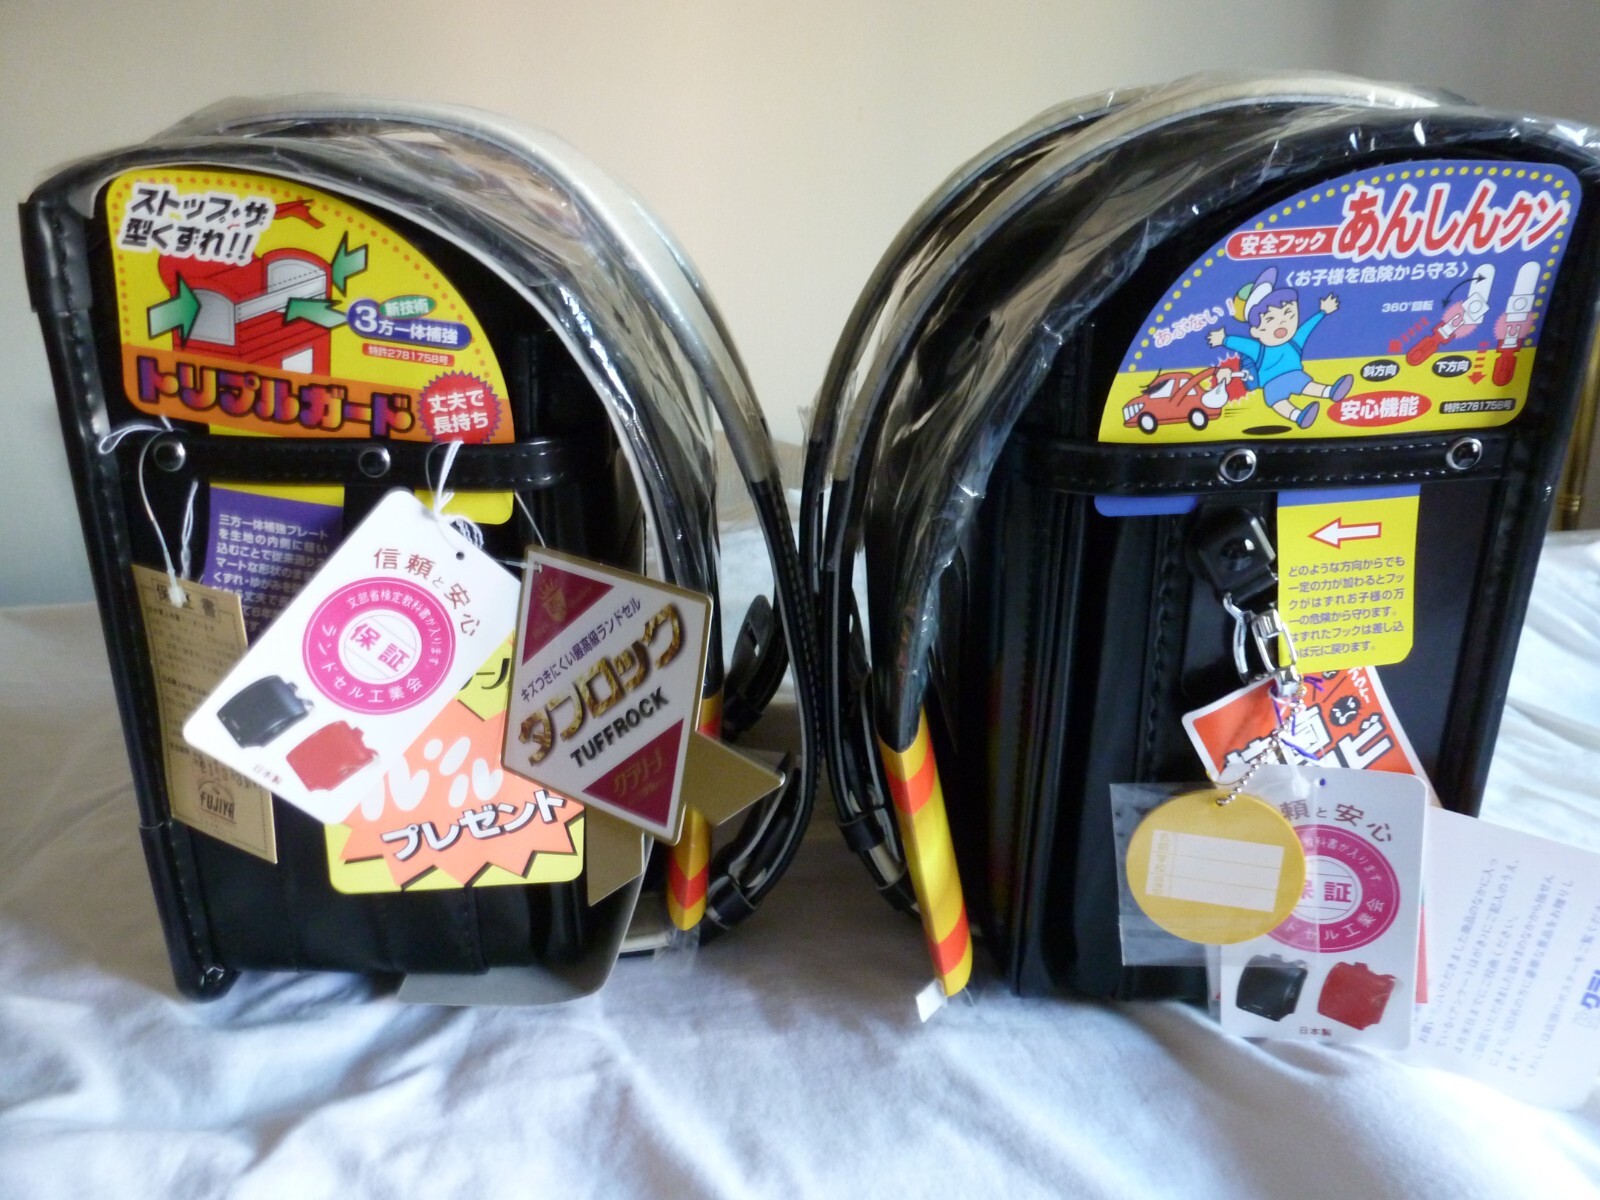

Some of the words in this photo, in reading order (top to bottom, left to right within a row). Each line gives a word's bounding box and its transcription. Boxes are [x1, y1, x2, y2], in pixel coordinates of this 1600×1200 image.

[1335, 182, 1568, 260] あんしんクン
[1239, 231, 1327, 256] 安全フック
[384, 298, 430, 317] 新技術
[1436, 360, 1470, 373] 下方向
[135, 356, 416, 438] トリプルガード
[427, 390, 485, 415] 丈夫で
[1340, 395, 1420, 422] 安心機能
[432, 411, 489, 436] 長持ち
[1289, 556, 1405, 577] どのような方向からでも
[374, 548, 480, 637] 信頼と安心
[1288, 573, 1405, 593] 一定の力が加わるとフッ
[1289, 588, 1405, 610] クがはずれお子様の万
[347, 589, 443, 667] 文部省検定教科書が入ります
[1289, 606, 1397, 625] 一の危険から守ります。
[1291, 621, 1404, 643] はずれたフックは差し込
[350, 623, 410, 673] 保証
[521, 596, 642, 704] キズつきにくい最高級ランドセル
[318, 624, 424, 703] ランドセル工業会
[518, 603, 685, 767] タフロック
[570, 686, 671, 768] TUFFROCK
[200, 791, 235, 819] FUJIYA
[380, 789, 565, 861] プレゼント
[1280, 799, 1392, 842] 頼と安心
[1299, 1026, 1332, 1037] 日本製
